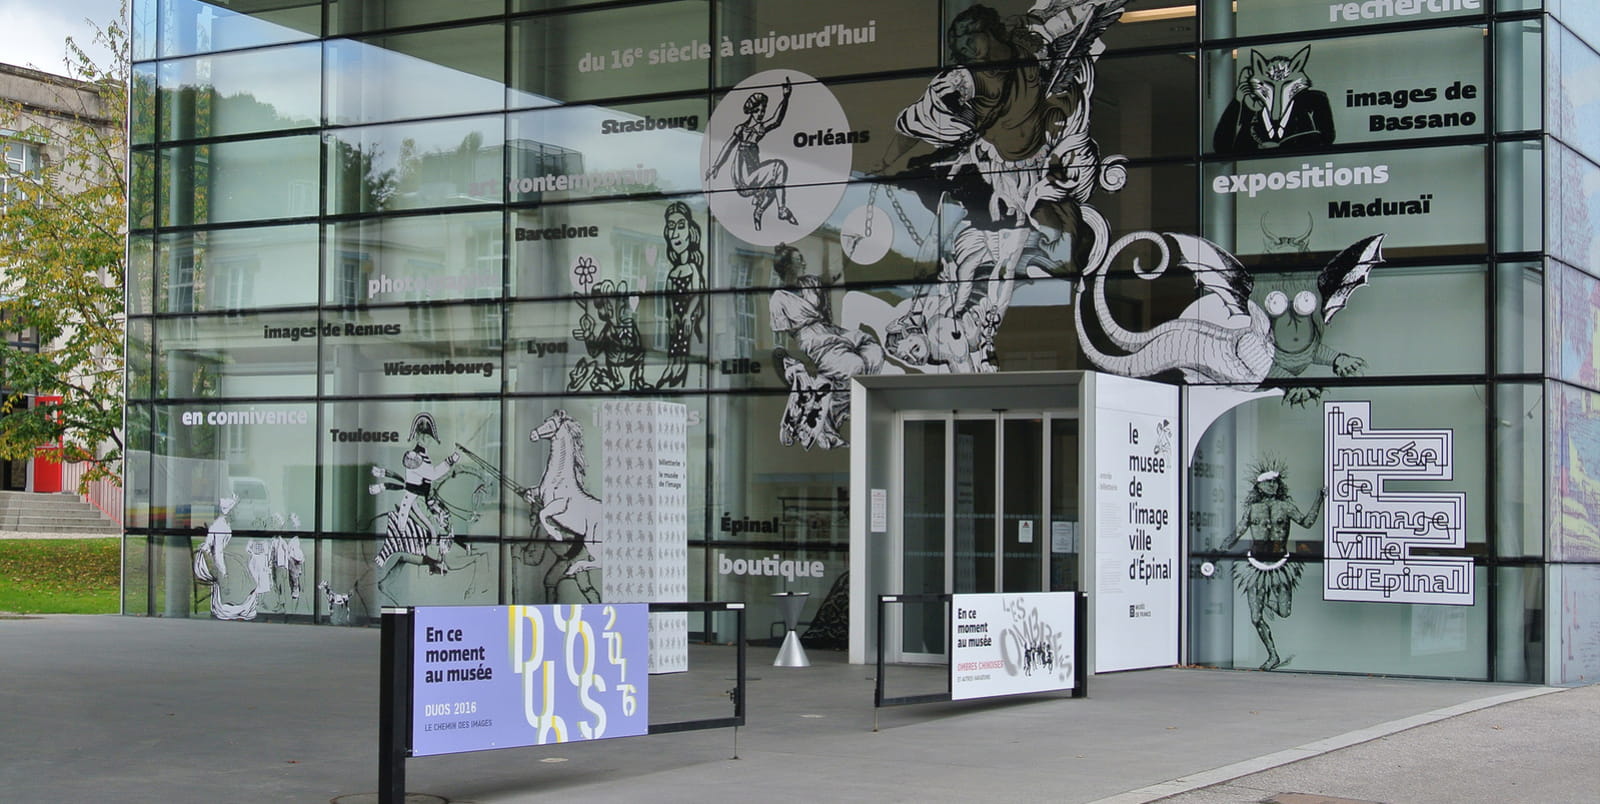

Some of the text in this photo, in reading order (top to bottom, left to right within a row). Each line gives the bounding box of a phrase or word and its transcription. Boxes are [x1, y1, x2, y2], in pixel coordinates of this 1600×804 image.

[1329, 0, 1480, 22] recherche
[578, 52, 607, 74] du
[648, 39, 711, 66] siècle
[720, 36, 734, 57] à
[739, 21, 877, 59] aujourd'hui
[1345, 81, 1477, 109] images de
[601, 112, 699, 135] Strasbourg
[1369, 110, 1477, 132] Bassano
[793, 127, 870, 148] Orléans
[467, 163, 658, 197] art contemporain
[1212, 162, 1390, 198] expositions
[1328, 194, 1433, 219] Maduraï
[514, 222, 599, 242] Barcelone
[264, 321, 401, 341] images de Rennes
[526, 339, 569, 357] Lyon
[383, 360, 494, 378] Wissembourg
[721, 358, 762, 375] Lille
[182, 407, 308, 426] en connivence
[1333, 406, 1363, 436] le
[330, 428, 399, 443] Toulouse
[1129, 421, 1139, 445] le
[1333, 441, 1438, 467] musée
[1129, 475, 1143, 498] de
[1336, 473, 1373, 502] de
[720, 512, 780, 536] Épinal
[1129, 502, 1169, 531] l'image
[1129, 530, 1152, 551] ville
[1336, 533, 1402, 560] ville
[719, 554, 825, 582] boutique
[1129, 554, 1172, 585] d'Épinal
[957, 608, 977, 619] En ce
[1002, 596, 1026, 623] LES
[426, 627, 462, 643] En ce
[957, 622, 988, 634] moment
[957, 634, 992, 648] au musée
[425, 646, 485, 663] moment
[425, 663, 492, 683] au musée
[425, 702, 477, 717] DUOS 2016
[434, 722, 456, 731] CHEMIN
[458, 720, 470, 729] DES
[471, 719, 493, 728] IMAGES
